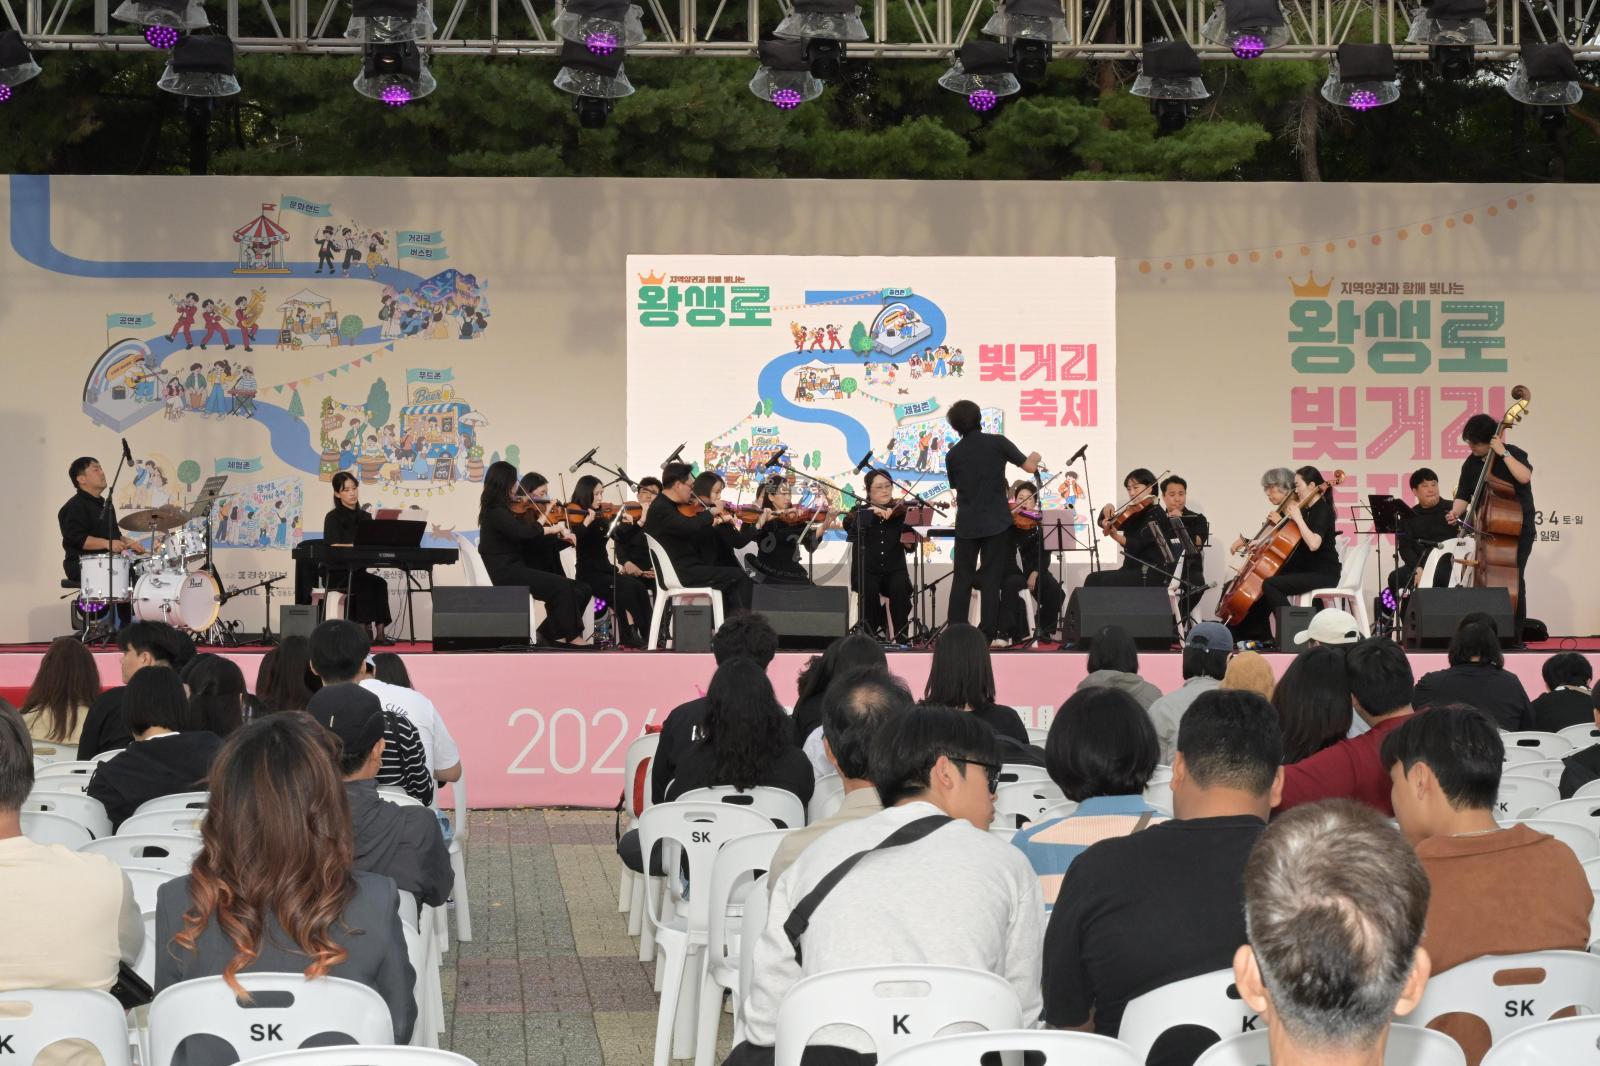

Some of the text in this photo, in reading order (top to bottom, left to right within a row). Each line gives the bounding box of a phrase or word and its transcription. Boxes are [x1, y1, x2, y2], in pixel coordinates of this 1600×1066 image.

[410, 249, 432, 257] 버스킹
[1340, 281, 1464, 295] 지역상권과 함께 빛나는
[638, 285, 772, 327] 왕생로
[1288, 299, 1508, 374] 왕생로
[979, 343, 1098, 381] 빛거리
[1020, 388, 1098, 427] 축제
[1540, 530, 1560, 542] 일원
[691, 831, 711, 843] SK
[1504, 999, 1535, 1017] SK
[250, 1023, 283, 1041] SK
[892, 1014, 911, 1034] K
